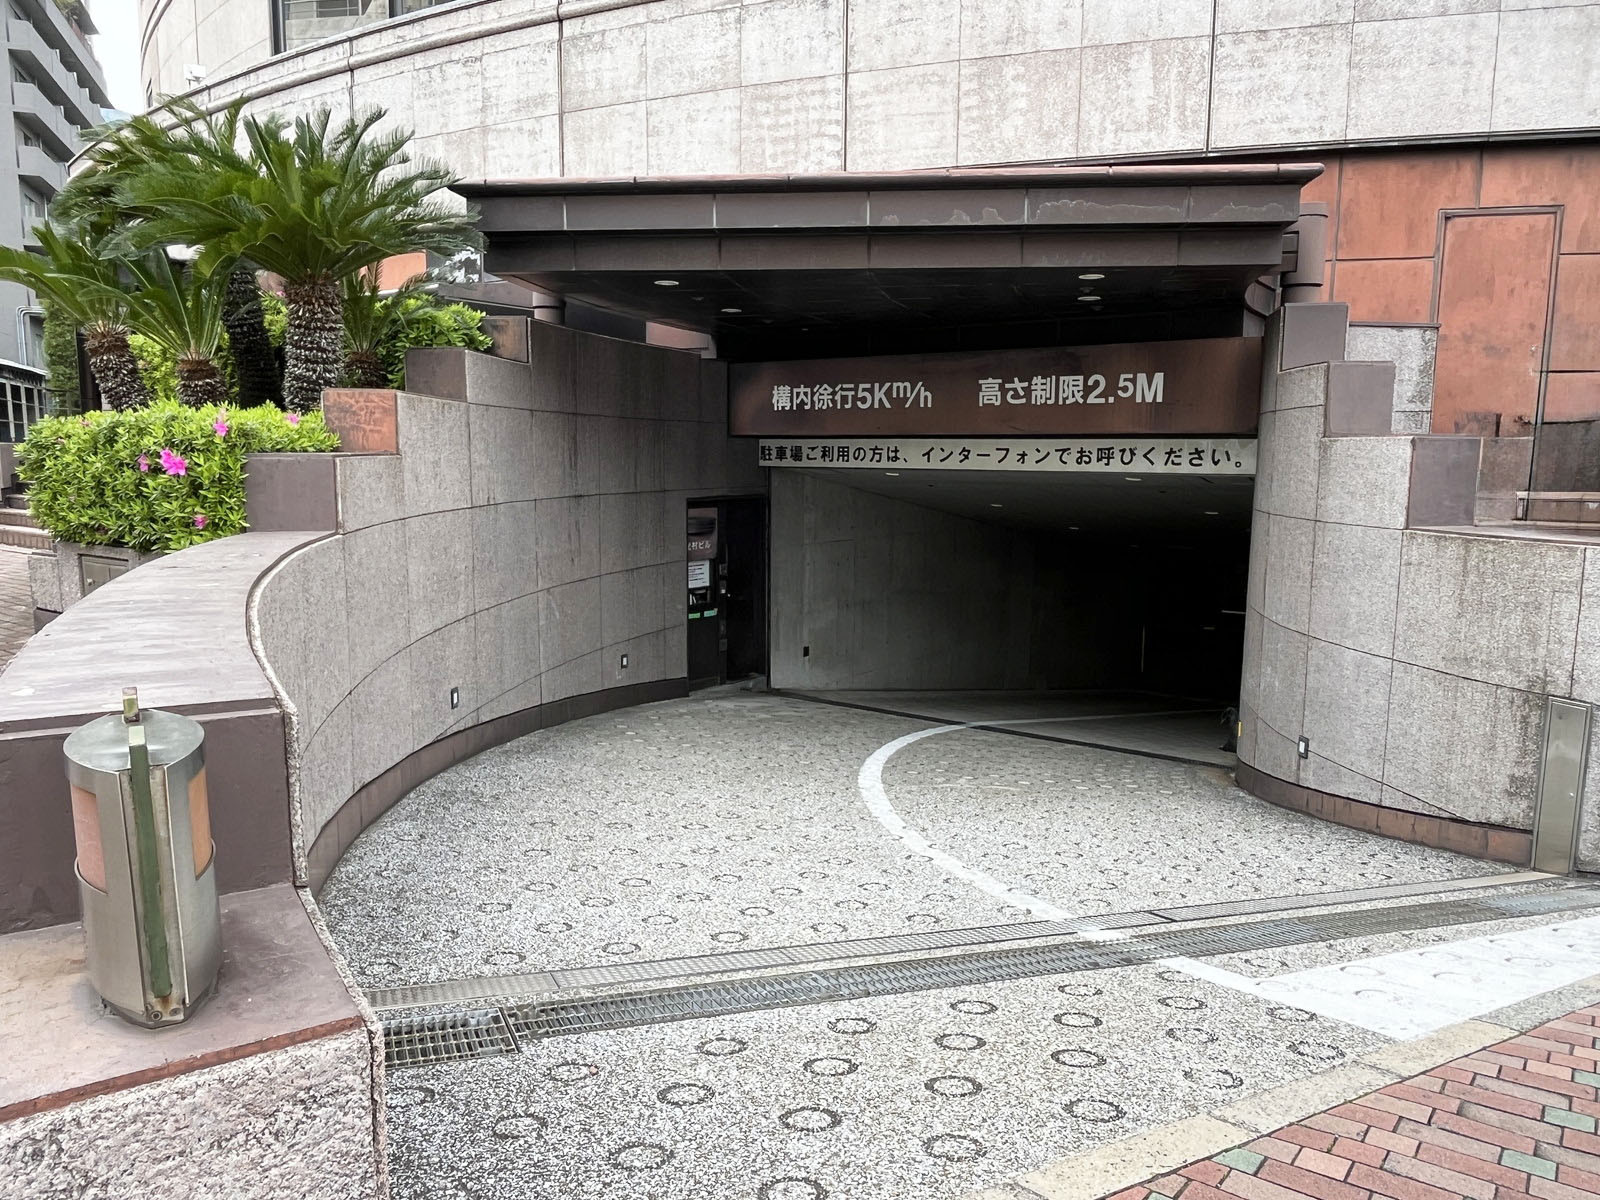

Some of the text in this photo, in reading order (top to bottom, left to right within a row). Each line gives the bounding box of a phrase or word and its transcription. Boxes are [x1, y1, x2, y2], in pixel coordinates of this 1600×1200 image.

[772, 372, 1165, 411] 構内徐行5Km/h 高さ制限2.5M
